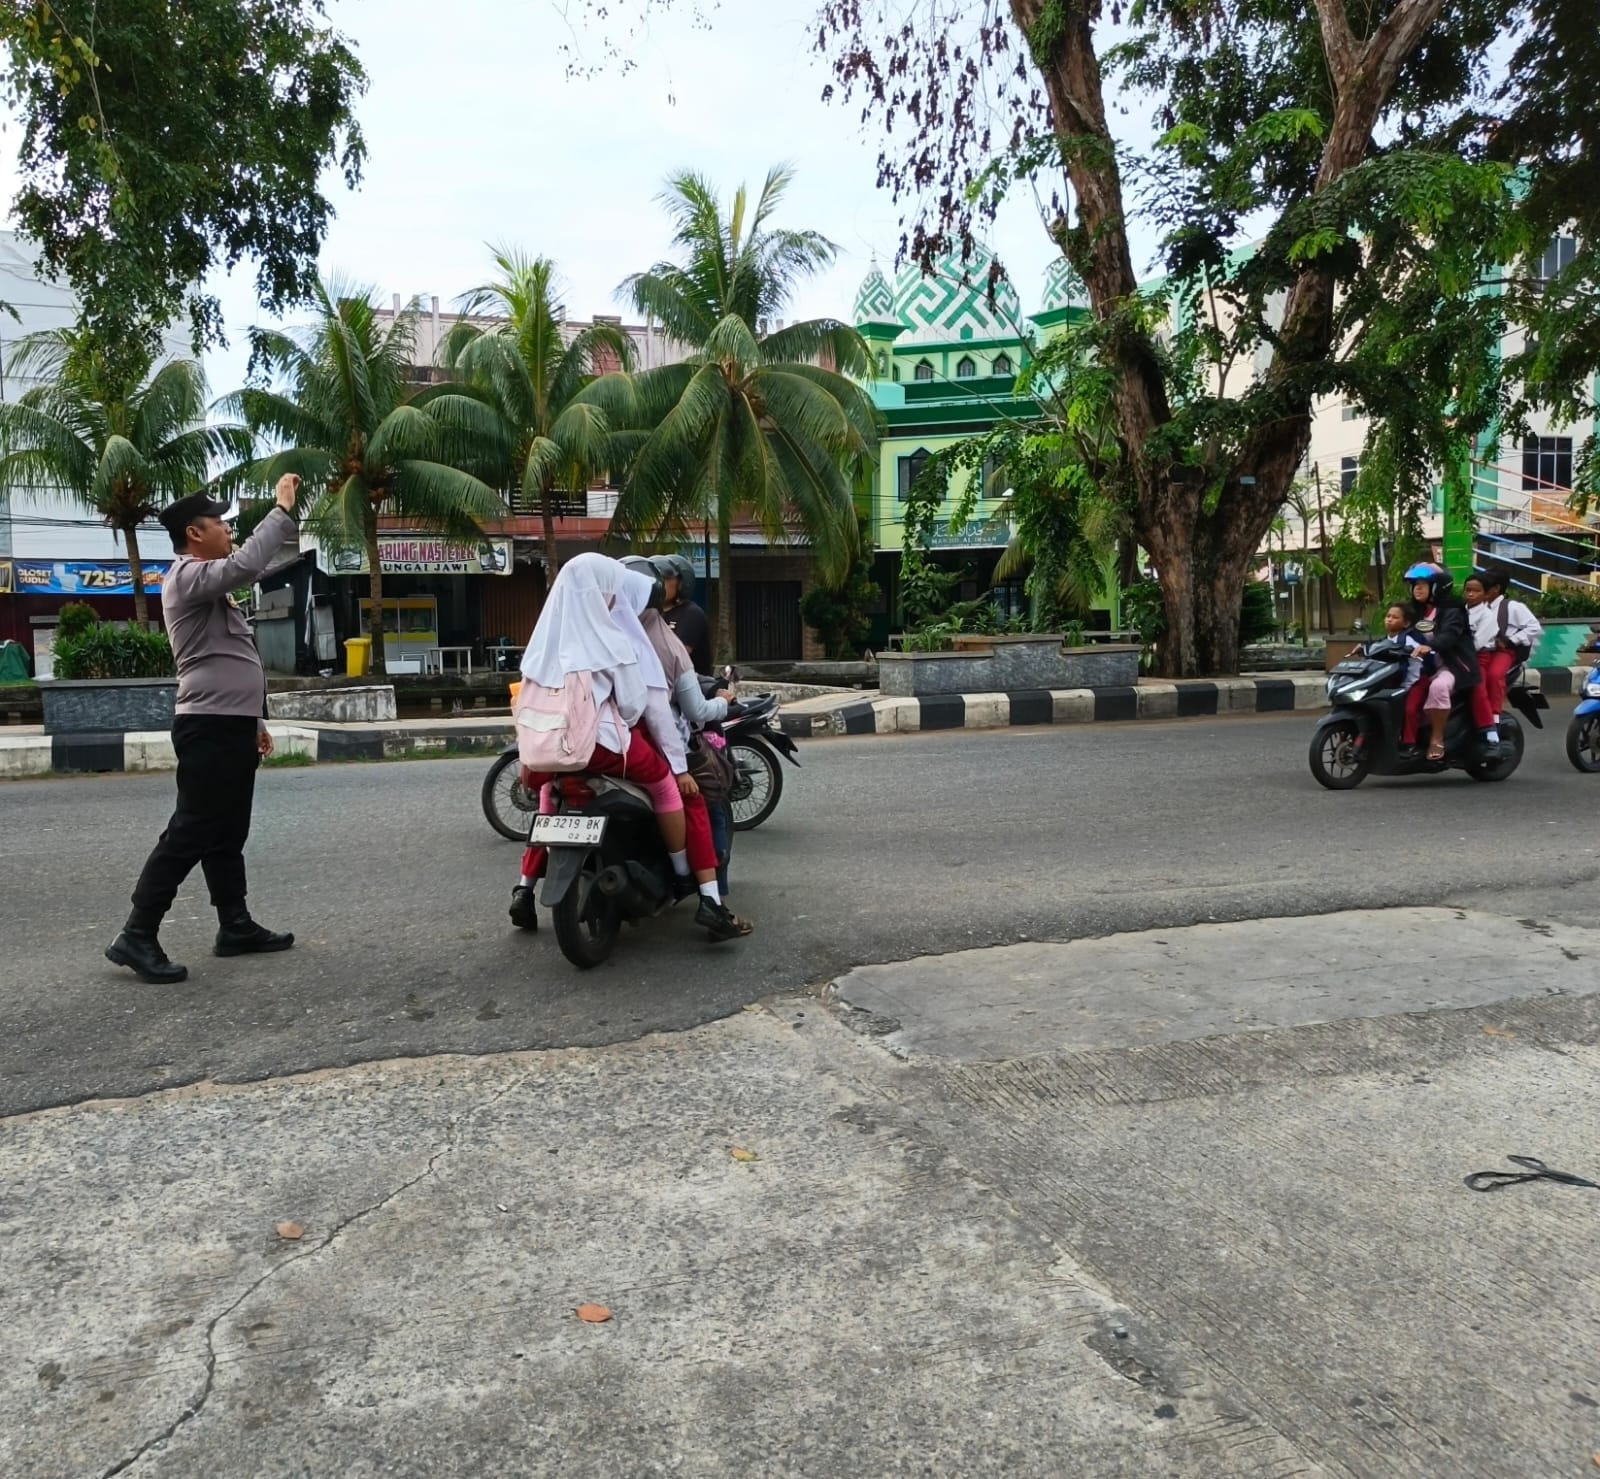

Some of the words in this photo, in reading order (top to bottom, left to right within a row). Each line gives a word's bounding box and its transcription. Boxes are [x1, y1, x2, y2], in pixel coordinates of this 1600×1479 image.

[378, 542, 417, 561] ARUNG
[383, 563, 428, 572] UNGAI
[434, 563, 468, 572] JAWI
[535, 817, 550, 828] KB
[553, 818, 581, 829] 3219
